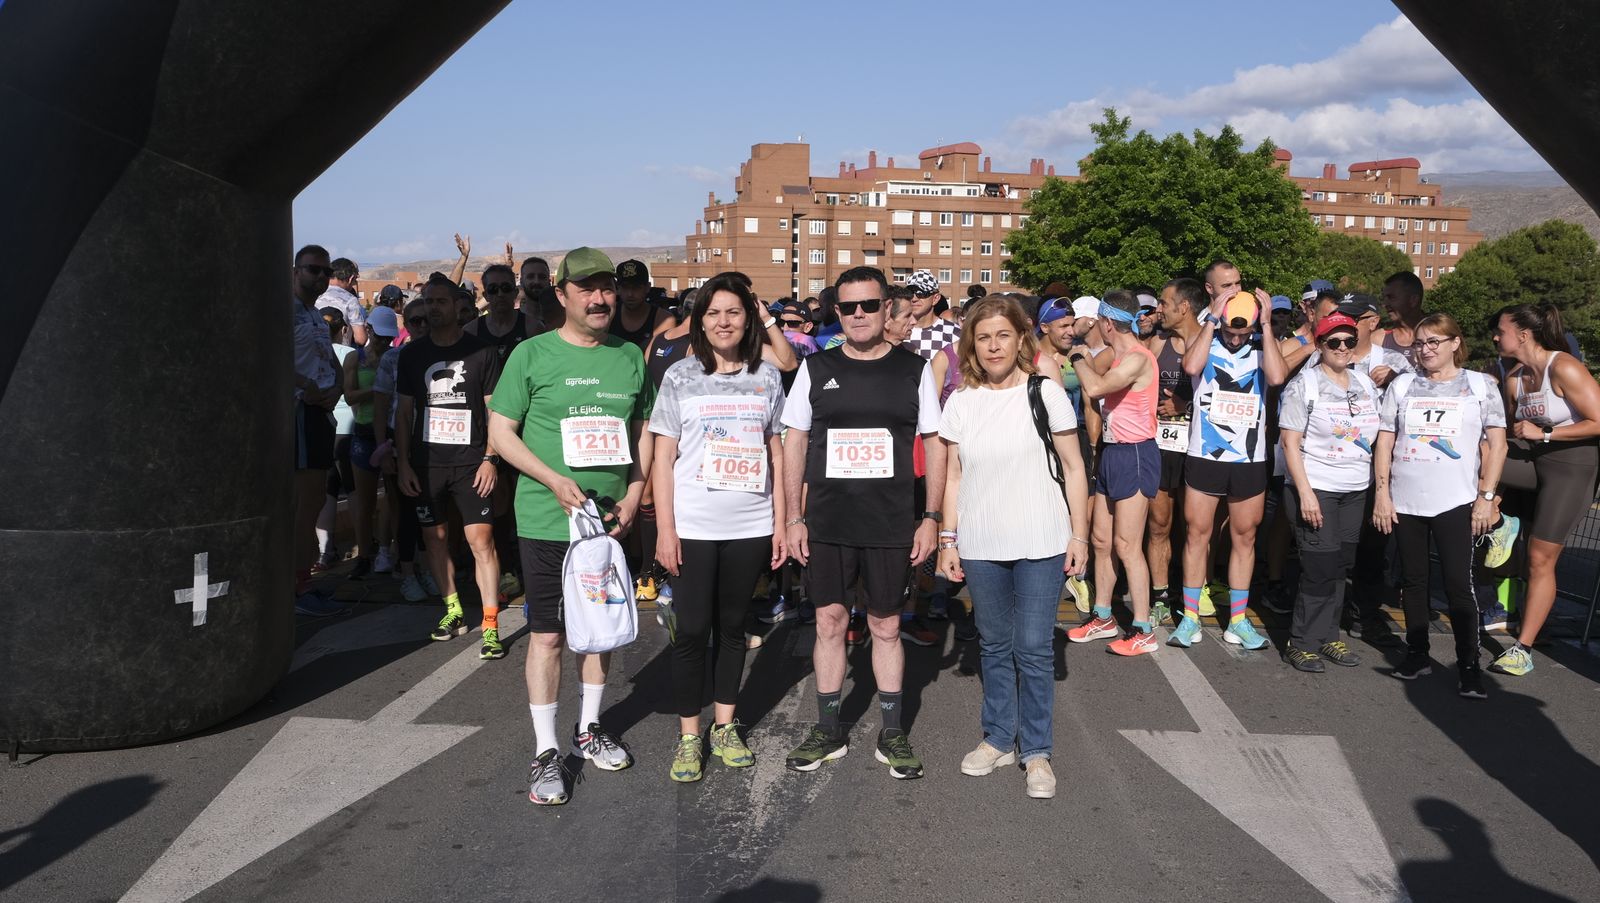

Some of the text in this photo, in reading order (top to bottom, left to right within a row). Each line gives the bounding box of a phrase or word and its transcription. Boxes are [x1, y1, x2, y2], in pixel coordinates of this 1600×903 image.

[569, 405, 603, 415] El Ejido
[1216, 401, 1254, 417] 1055
[1423, 409, 1446, 422] 17
[1520, 404, 1545, 418] 1089
[430, 419, 466, 433] 1170
[572, 433, 621, 450] 1211
[1162, 428, 1178, 441] 84
[834, 445, 886, 462] 1035
[712, 457, 761, 476] 1064
